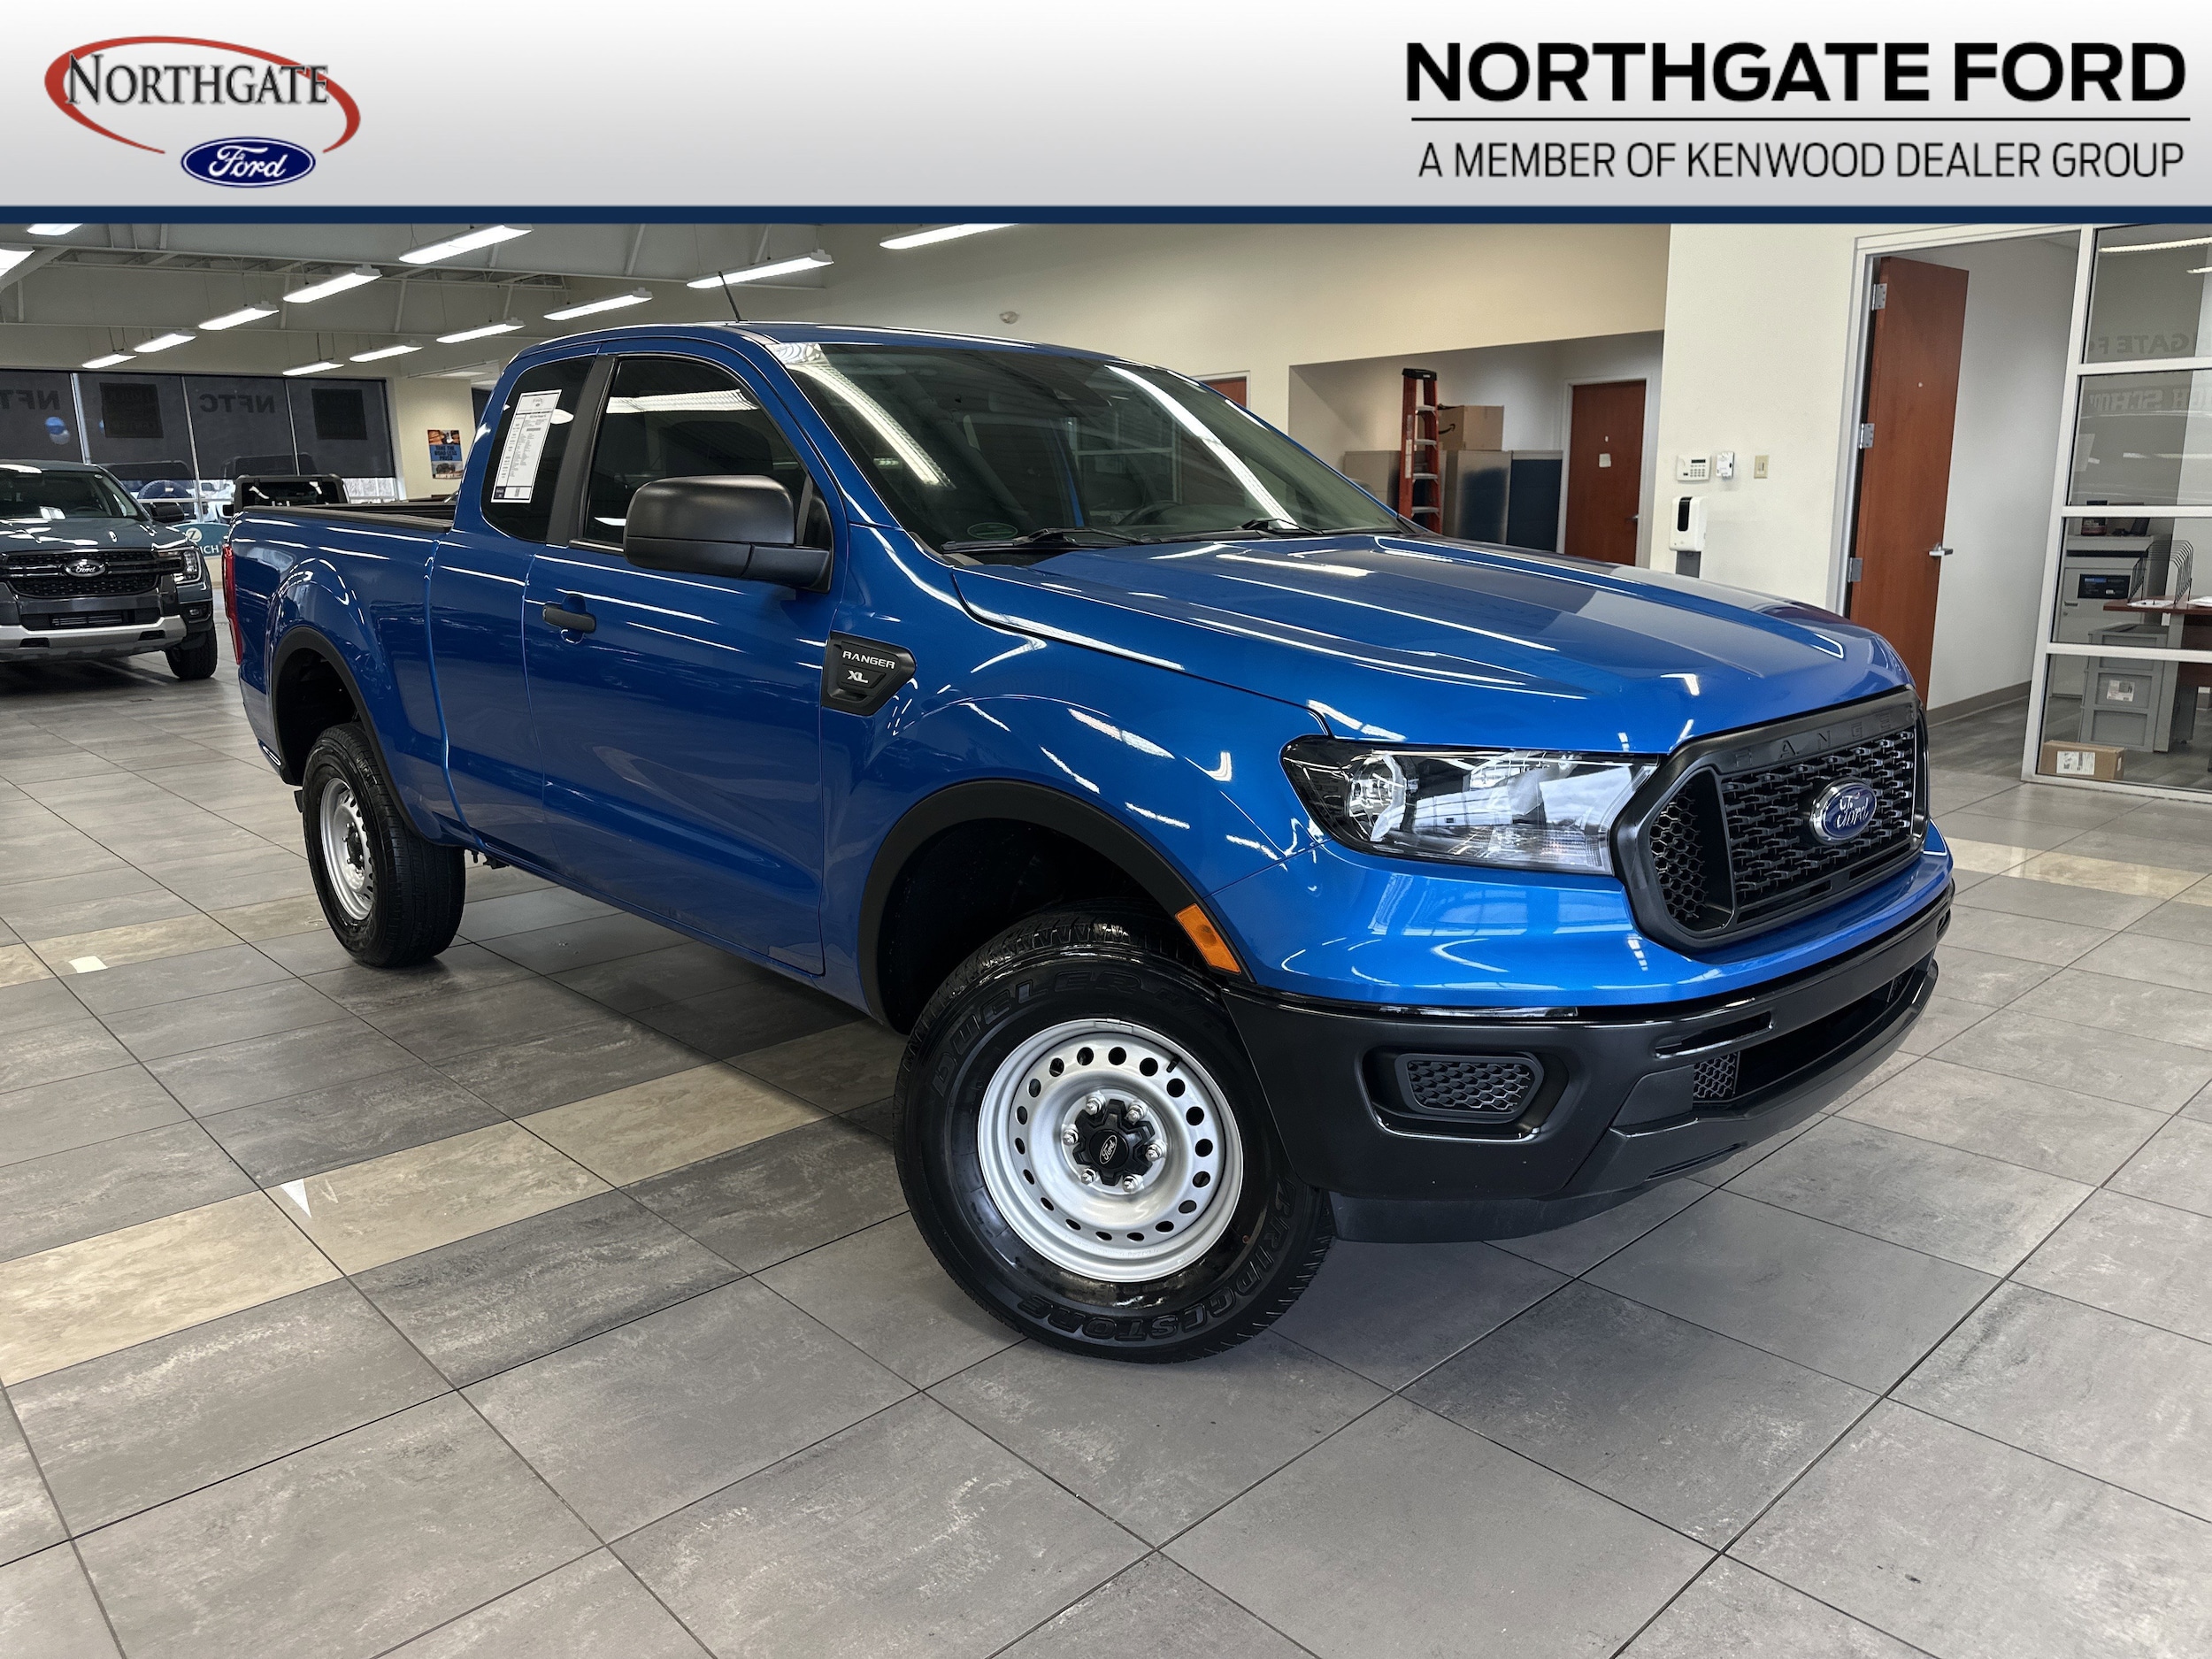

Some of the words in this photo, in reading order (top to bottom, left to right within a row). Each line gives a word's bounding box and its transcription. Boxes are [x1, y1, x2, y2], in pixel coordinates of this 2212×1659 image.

[199, 544, 219, 555] ICH
[75, 564, 96, 573] Ford
[842, 650, 895, 670] RANGER
[847, 670, 869, 684] XL
[1835, 793, 1870, 830] Ford
[1101, 1139, 1116, 1161] Ford
[1017, 1173, 1297, 1342] BRIDGESTONE
